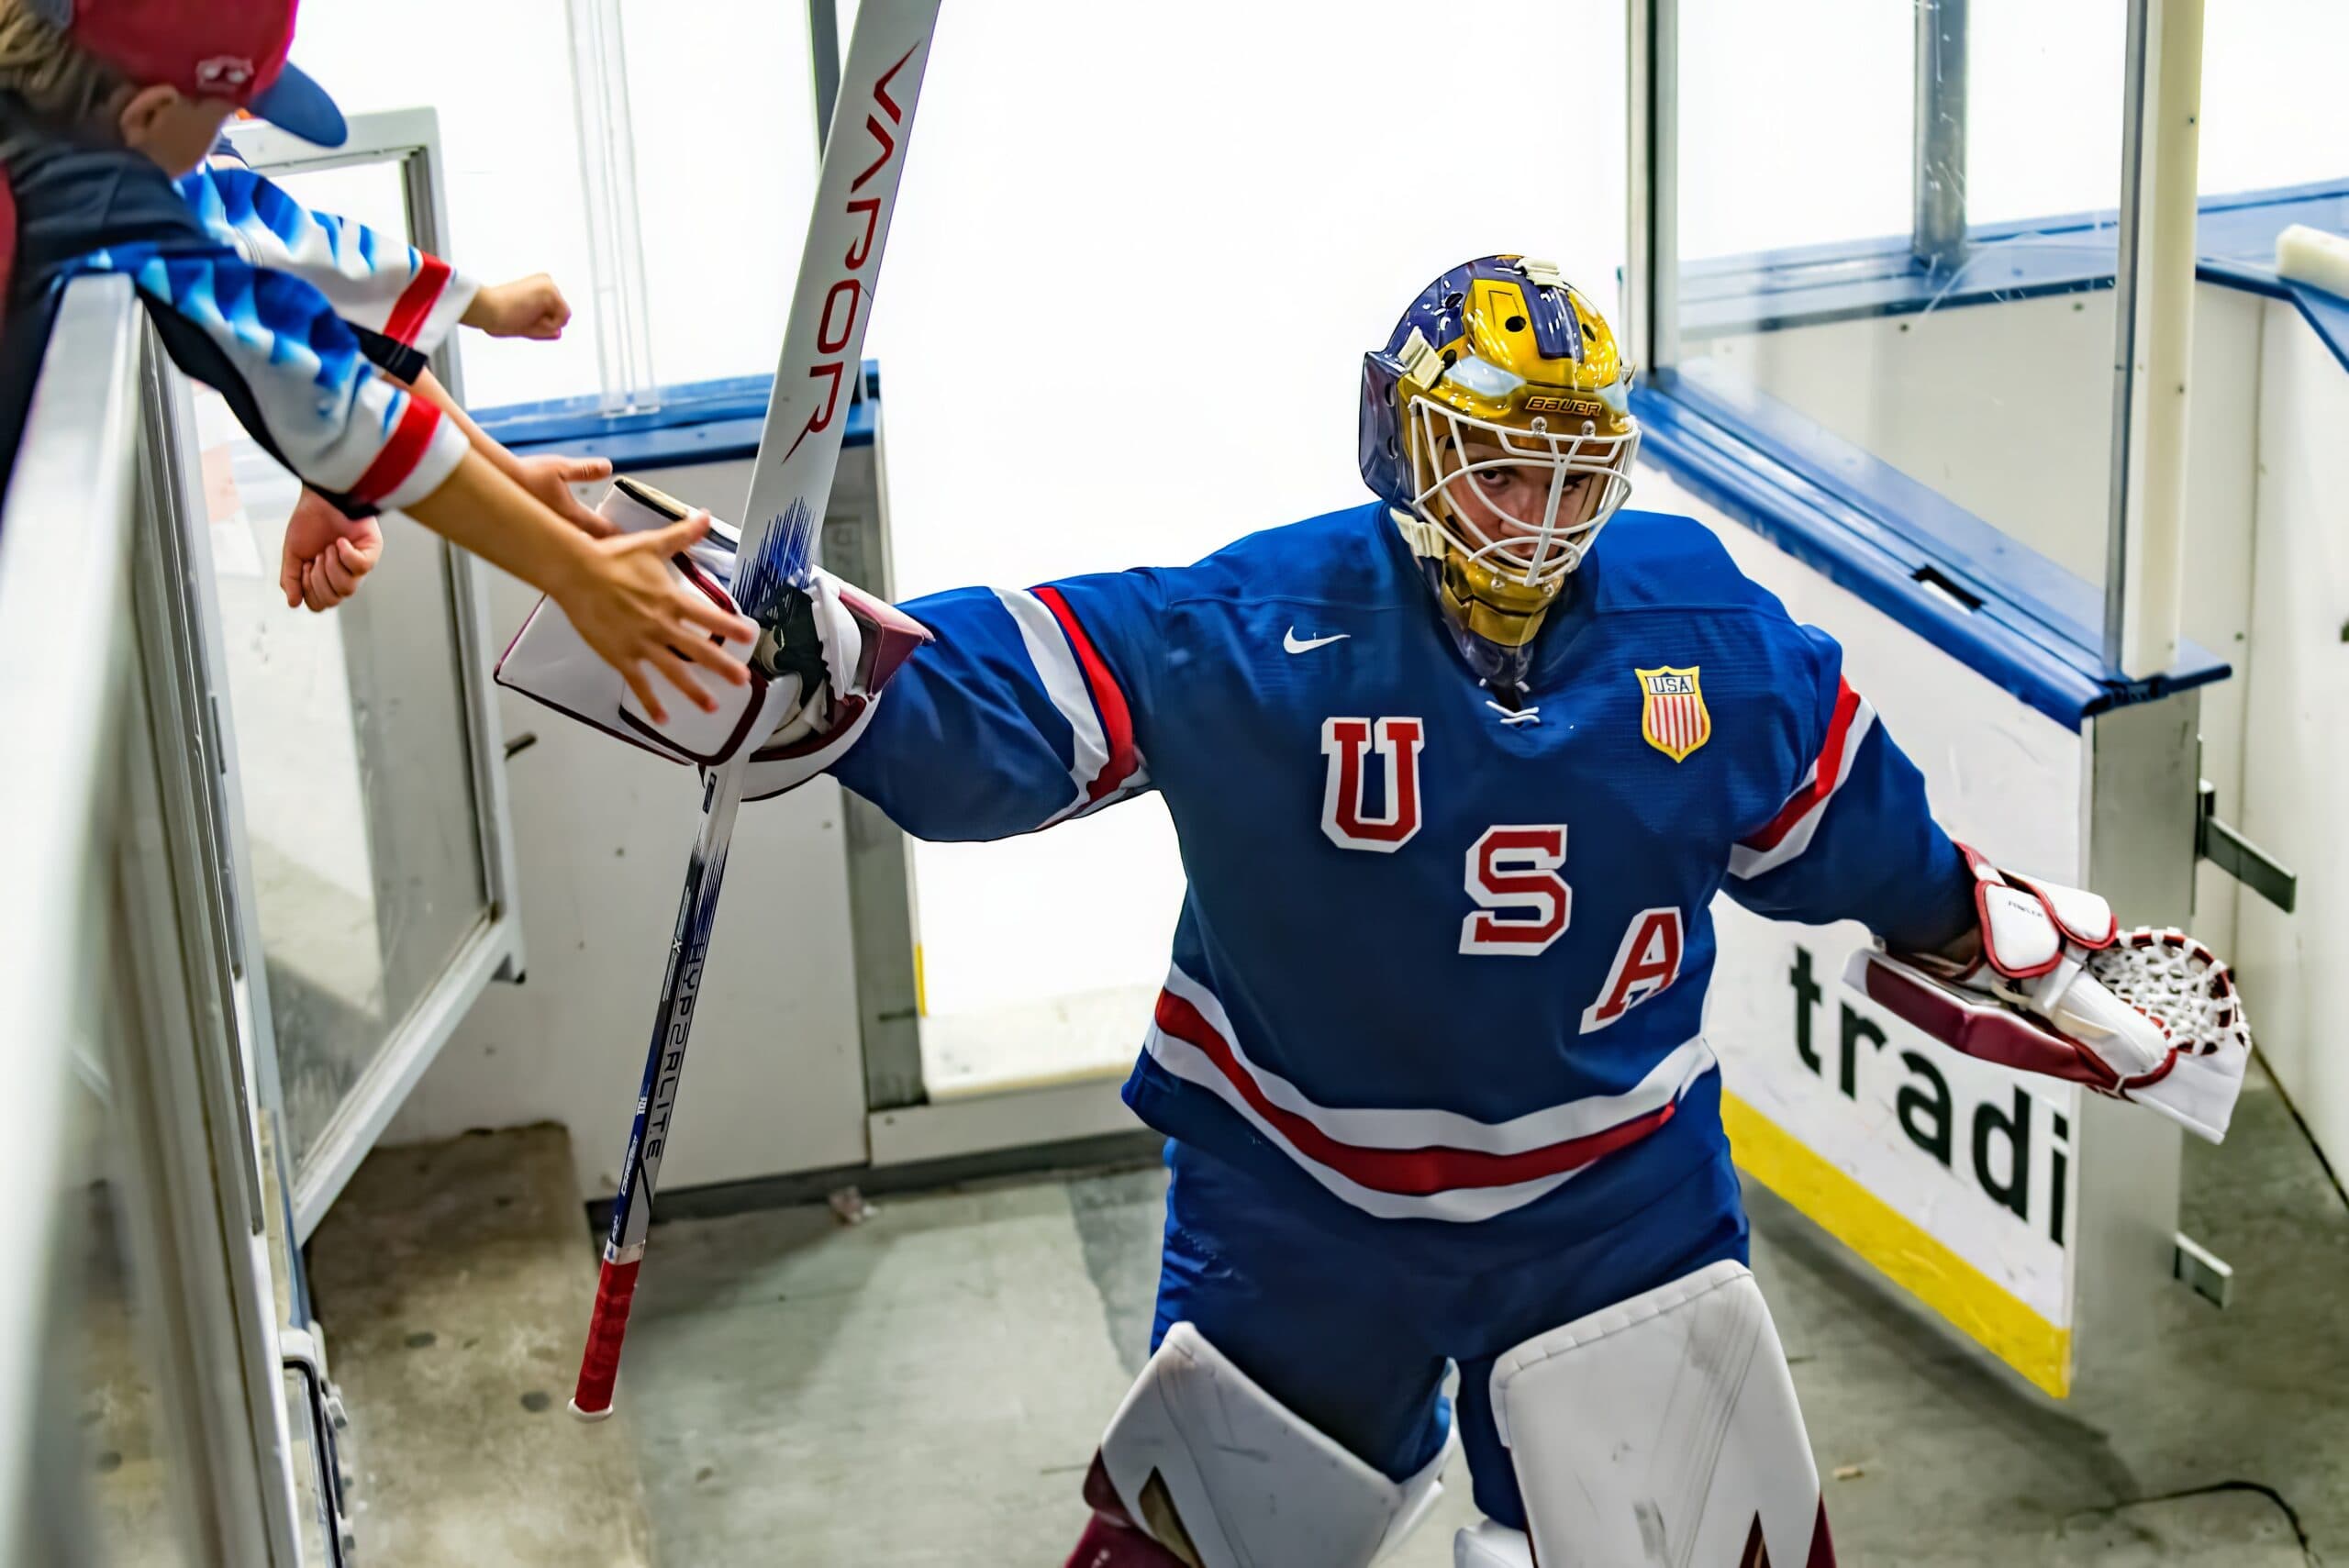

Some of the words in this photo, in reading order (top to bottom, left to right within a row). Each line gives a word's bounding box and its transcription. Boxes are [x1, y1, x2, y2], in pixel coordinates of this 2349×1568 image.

[782, 38, 921, 464] VAPOR
[1526, 396, 1602, 417] BAUER
[1653, 676, 1690, 692] USA
[1789, 944, 2069, 1249] tradi
